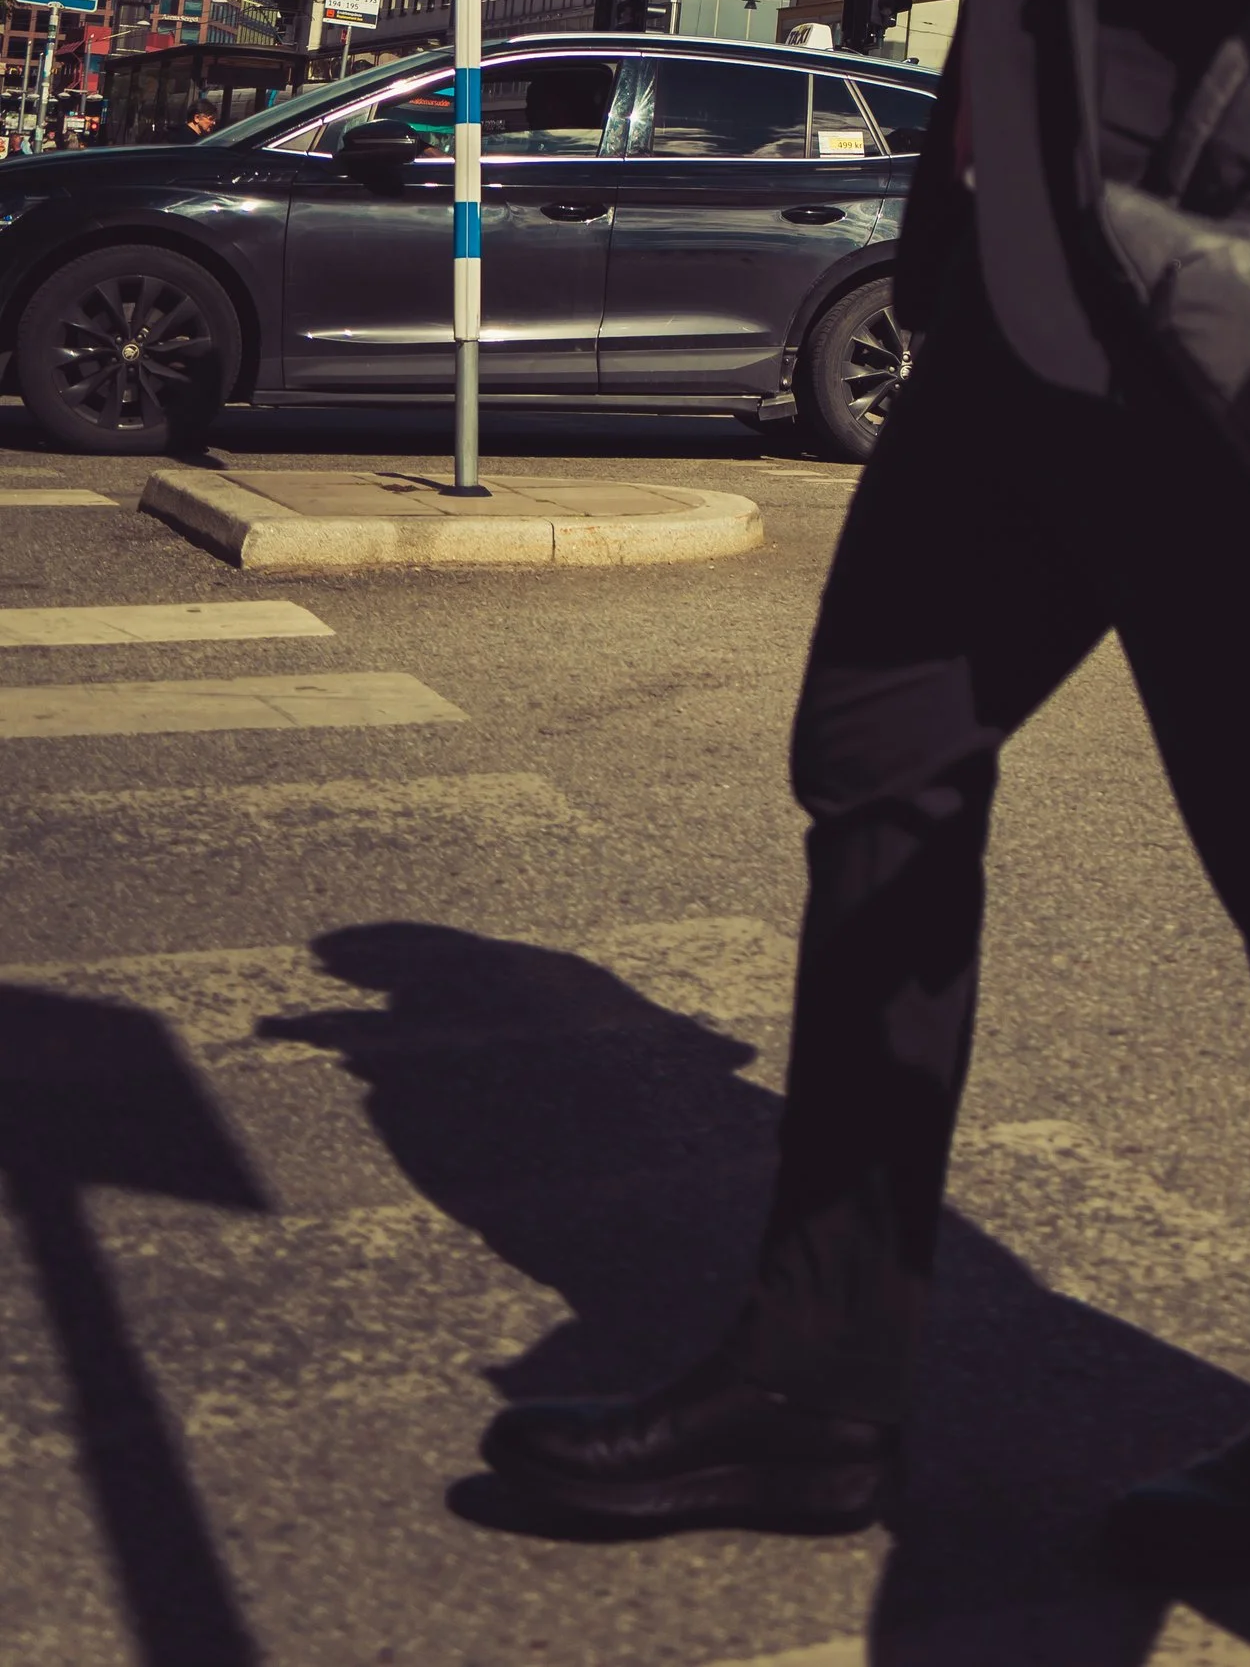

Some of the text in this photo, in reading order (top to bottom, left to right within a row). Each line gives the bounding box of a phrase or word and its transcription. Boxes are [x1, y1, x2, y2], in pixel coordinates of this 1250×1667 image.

[329, 0, 359, 10] 194 195
[788, 27, 811, 45] TAXI
[838, 141, 862, 149] 499 kr
